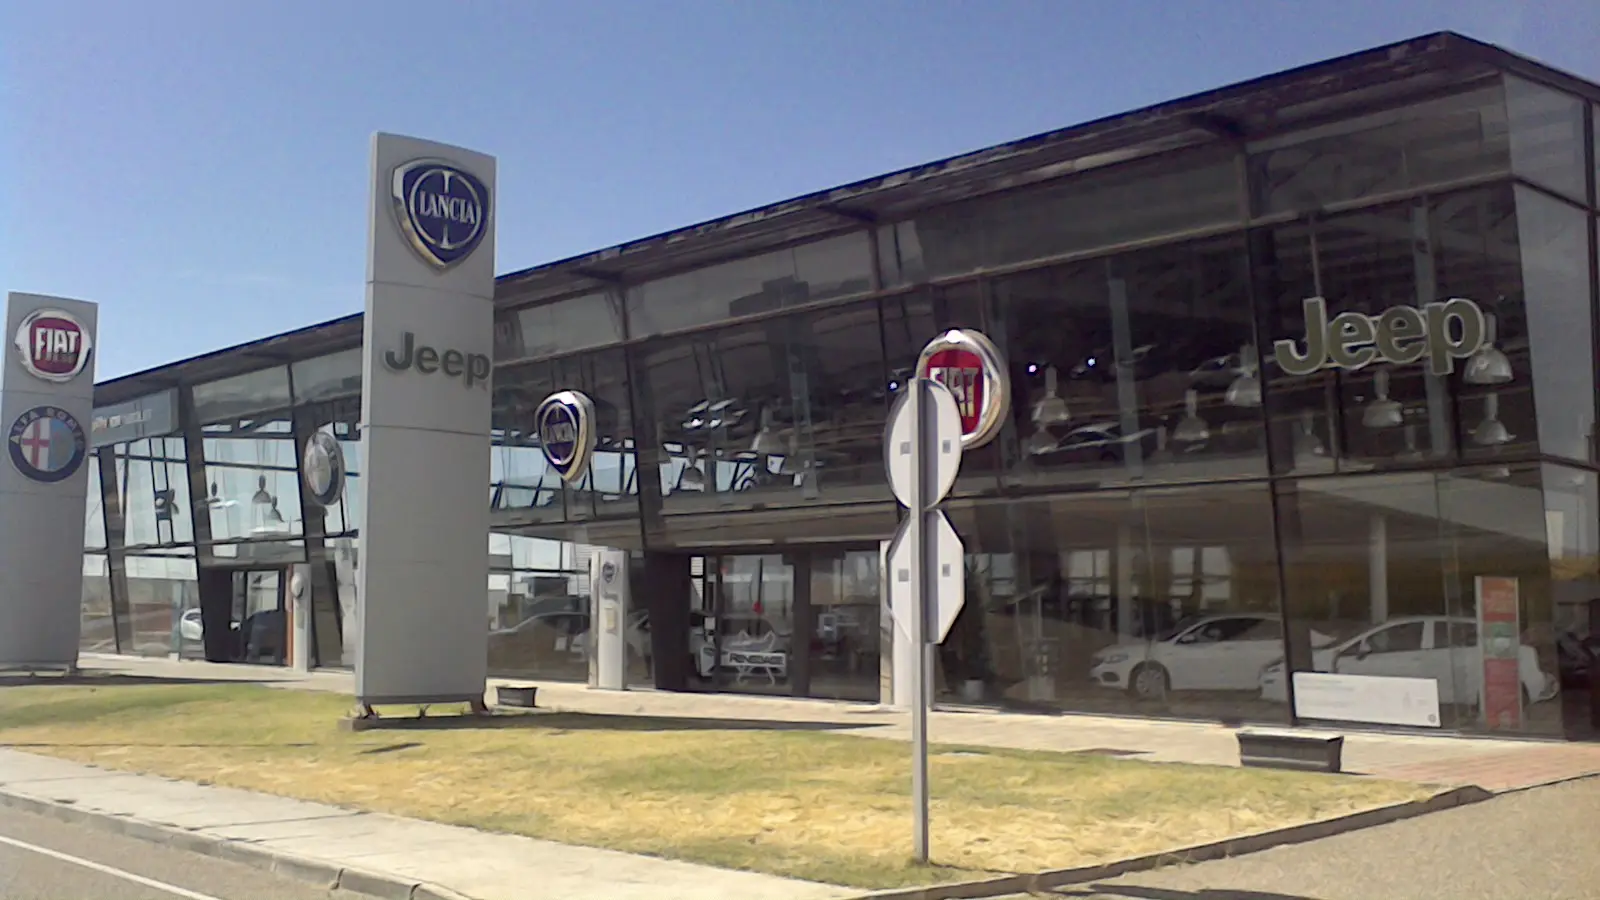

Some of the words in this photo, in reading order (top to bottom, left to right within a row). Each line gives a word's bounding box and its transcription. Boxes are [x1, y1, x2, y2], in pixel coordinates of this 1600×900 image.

[419, 190, 476, 225] LANCIA
[35, 327, 79, 363] FIAT
[1274, 296, 1485, 376] Jeep
[384, 331, 491, 388] Jeep
